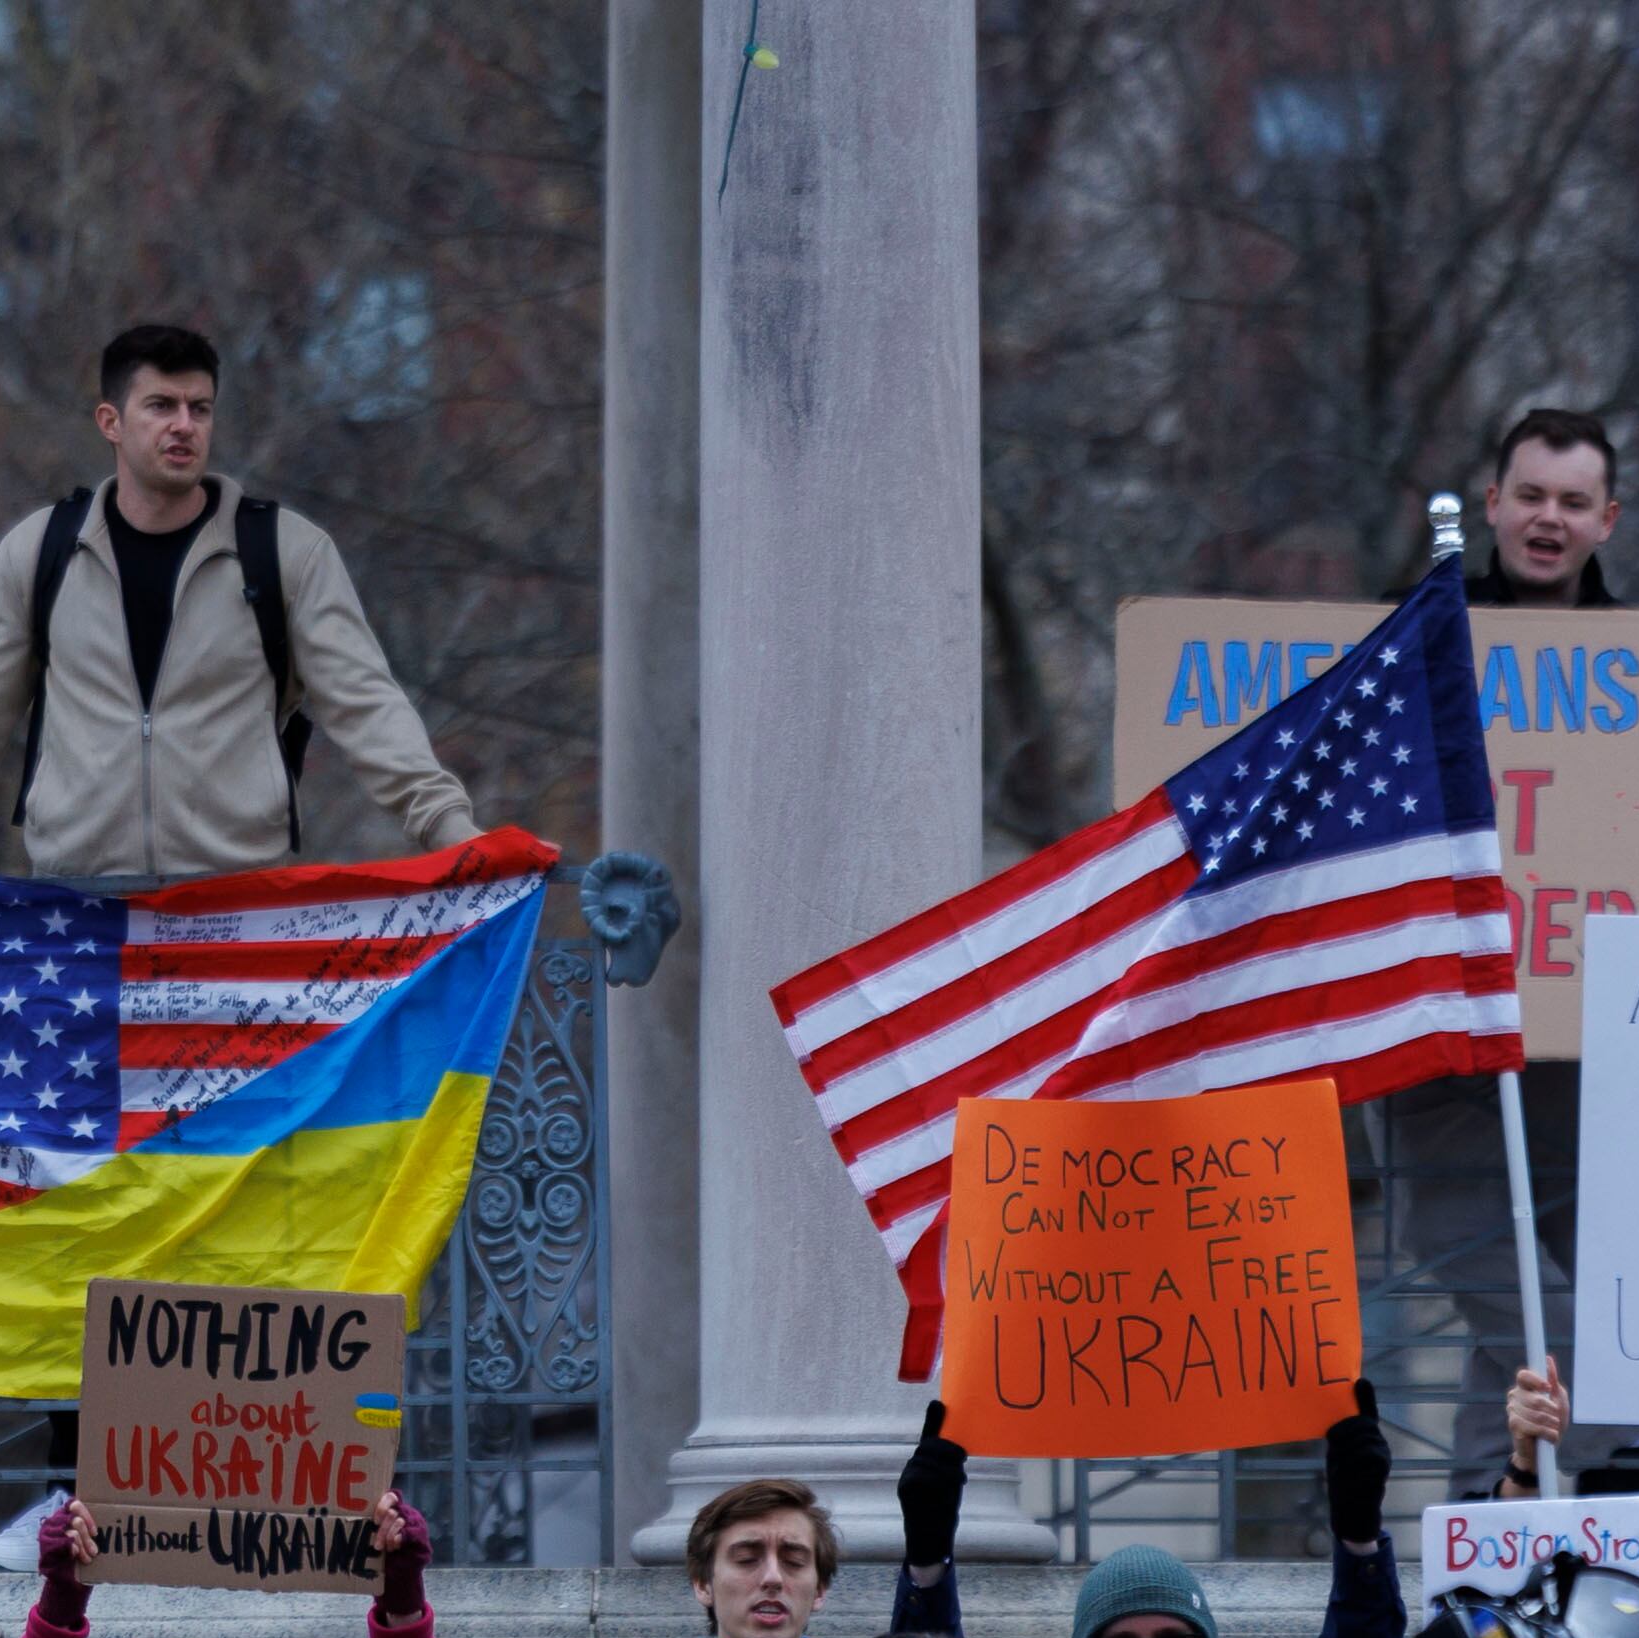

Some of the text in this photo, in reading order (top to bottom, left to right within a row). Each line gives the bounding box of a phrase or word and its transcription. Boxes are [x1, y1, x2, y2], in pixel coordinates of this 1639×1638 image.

[1164, 640, 1639, 734] AMEANS
[107, 1293, 372, 1382] NOTHING
[994, 1298, 1352, 1411] UKRAINE
[190, 1390, 321, 1442] about
[95, 1513, 203, 1557] without
[1446, 1517, 1574, 1572] Boston
